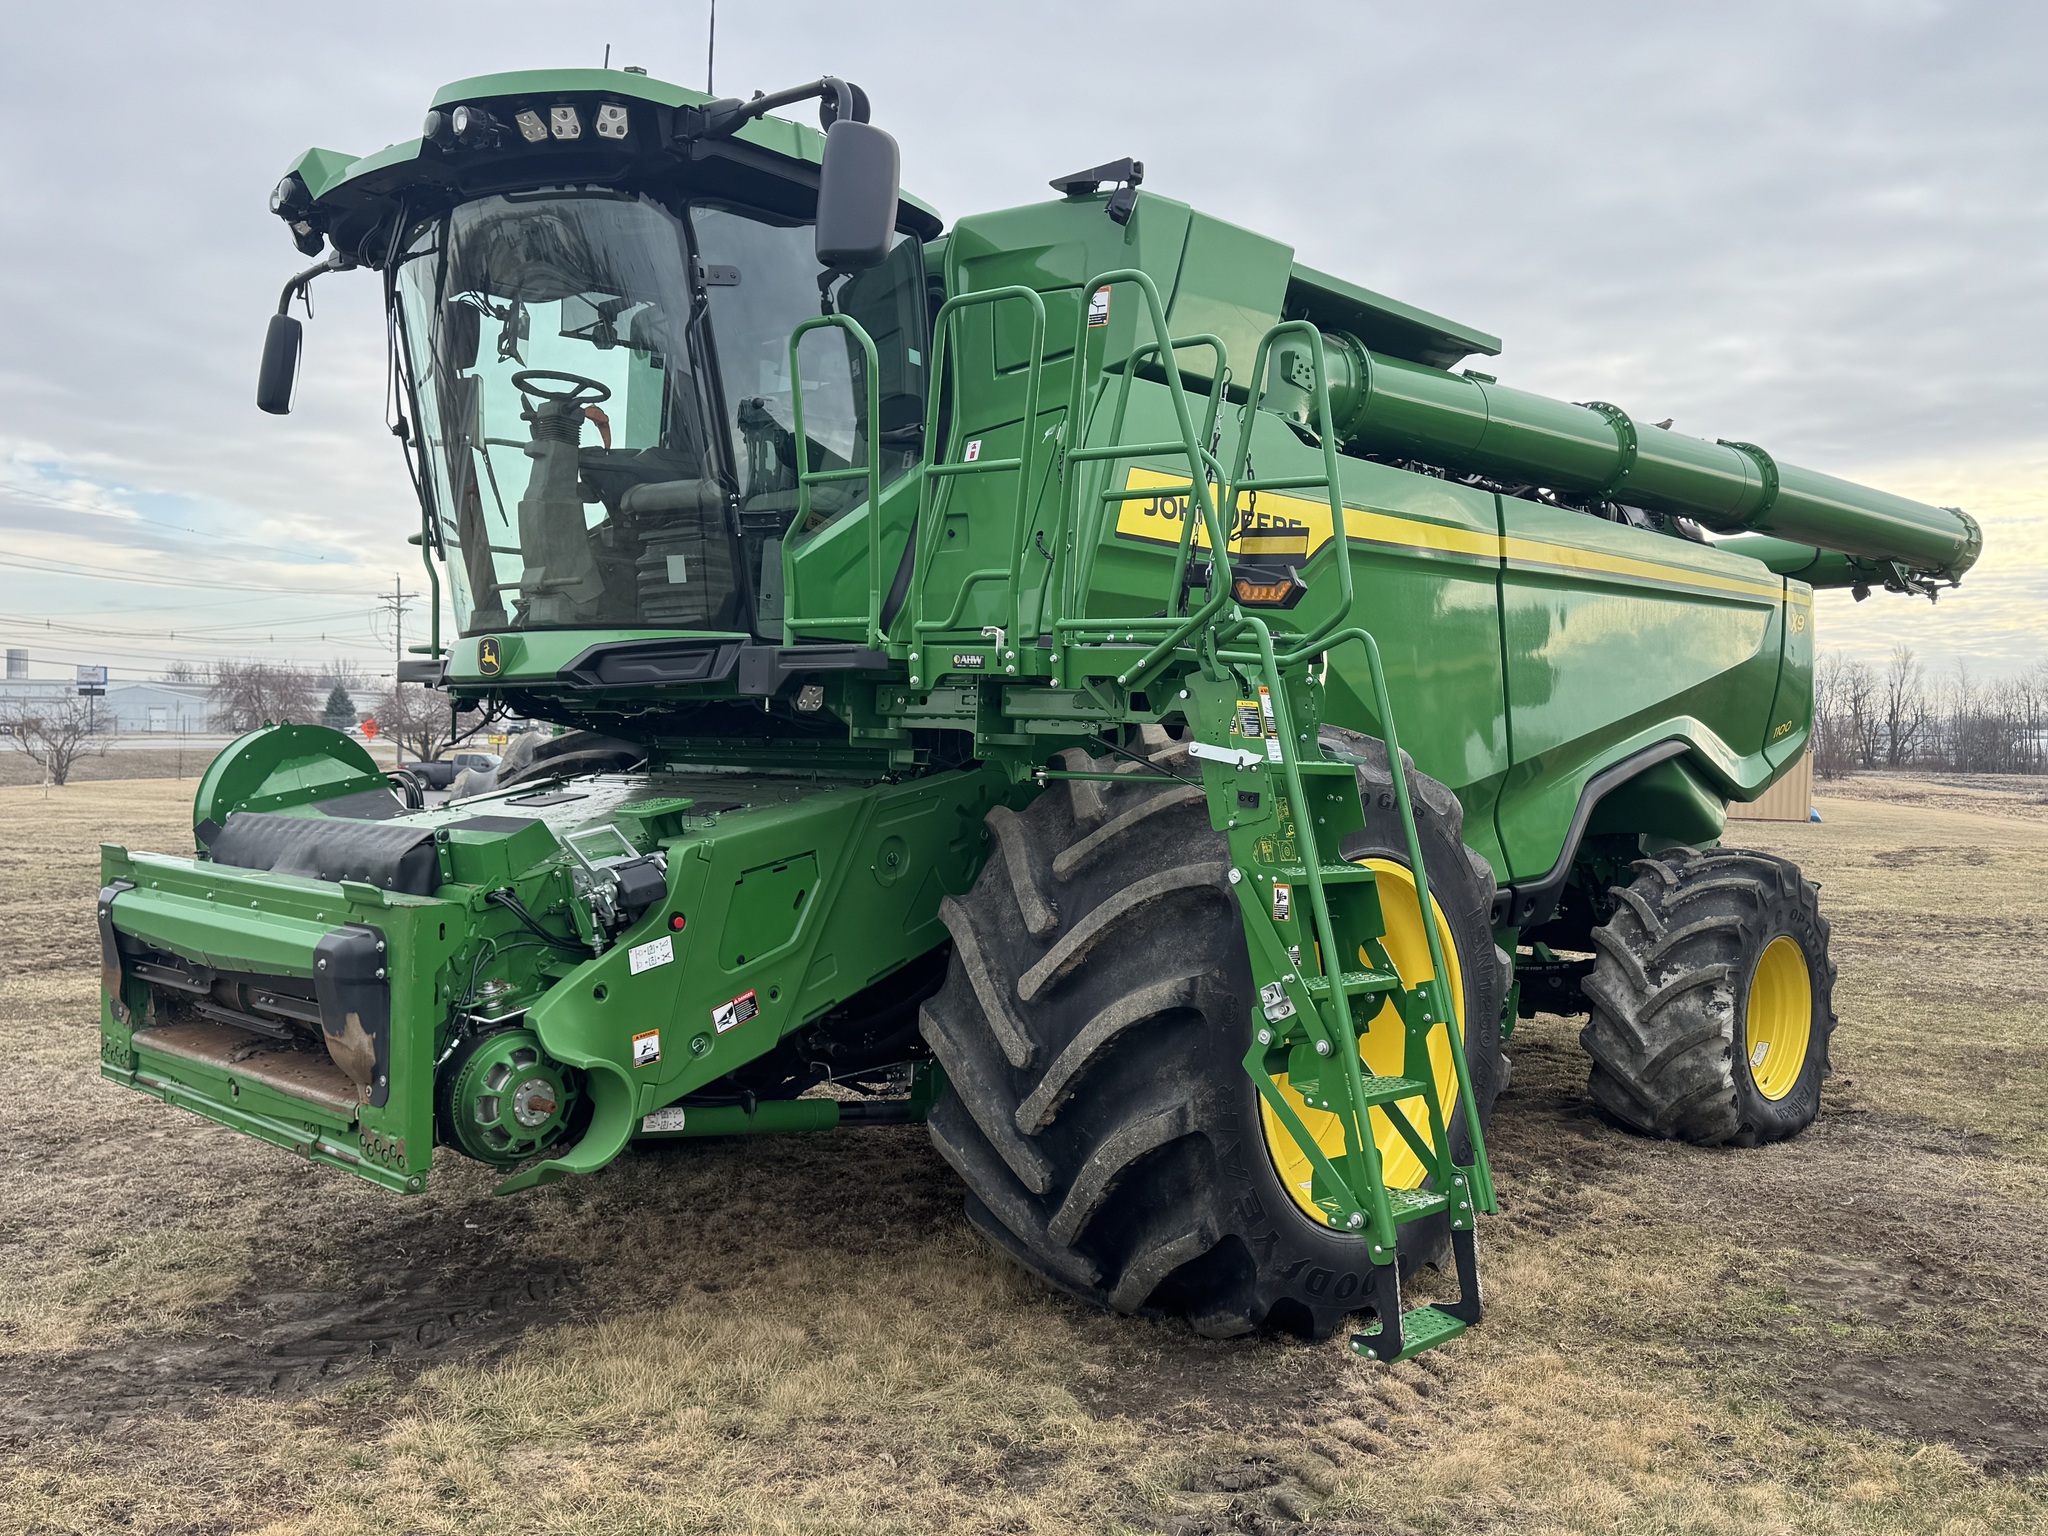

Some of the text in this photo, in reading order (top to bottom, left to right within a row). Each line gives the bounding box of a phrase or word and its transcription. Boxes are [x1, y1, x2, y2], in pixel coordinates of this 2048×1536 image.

[1144, 497, 1203, 525] JOH
[1791, 613, 1805, 633] X9
[960, 655, 982, 664] AHW
[1773, 720, 1792, 739] 1100
[737, 991, 753, 1002] DANGER
